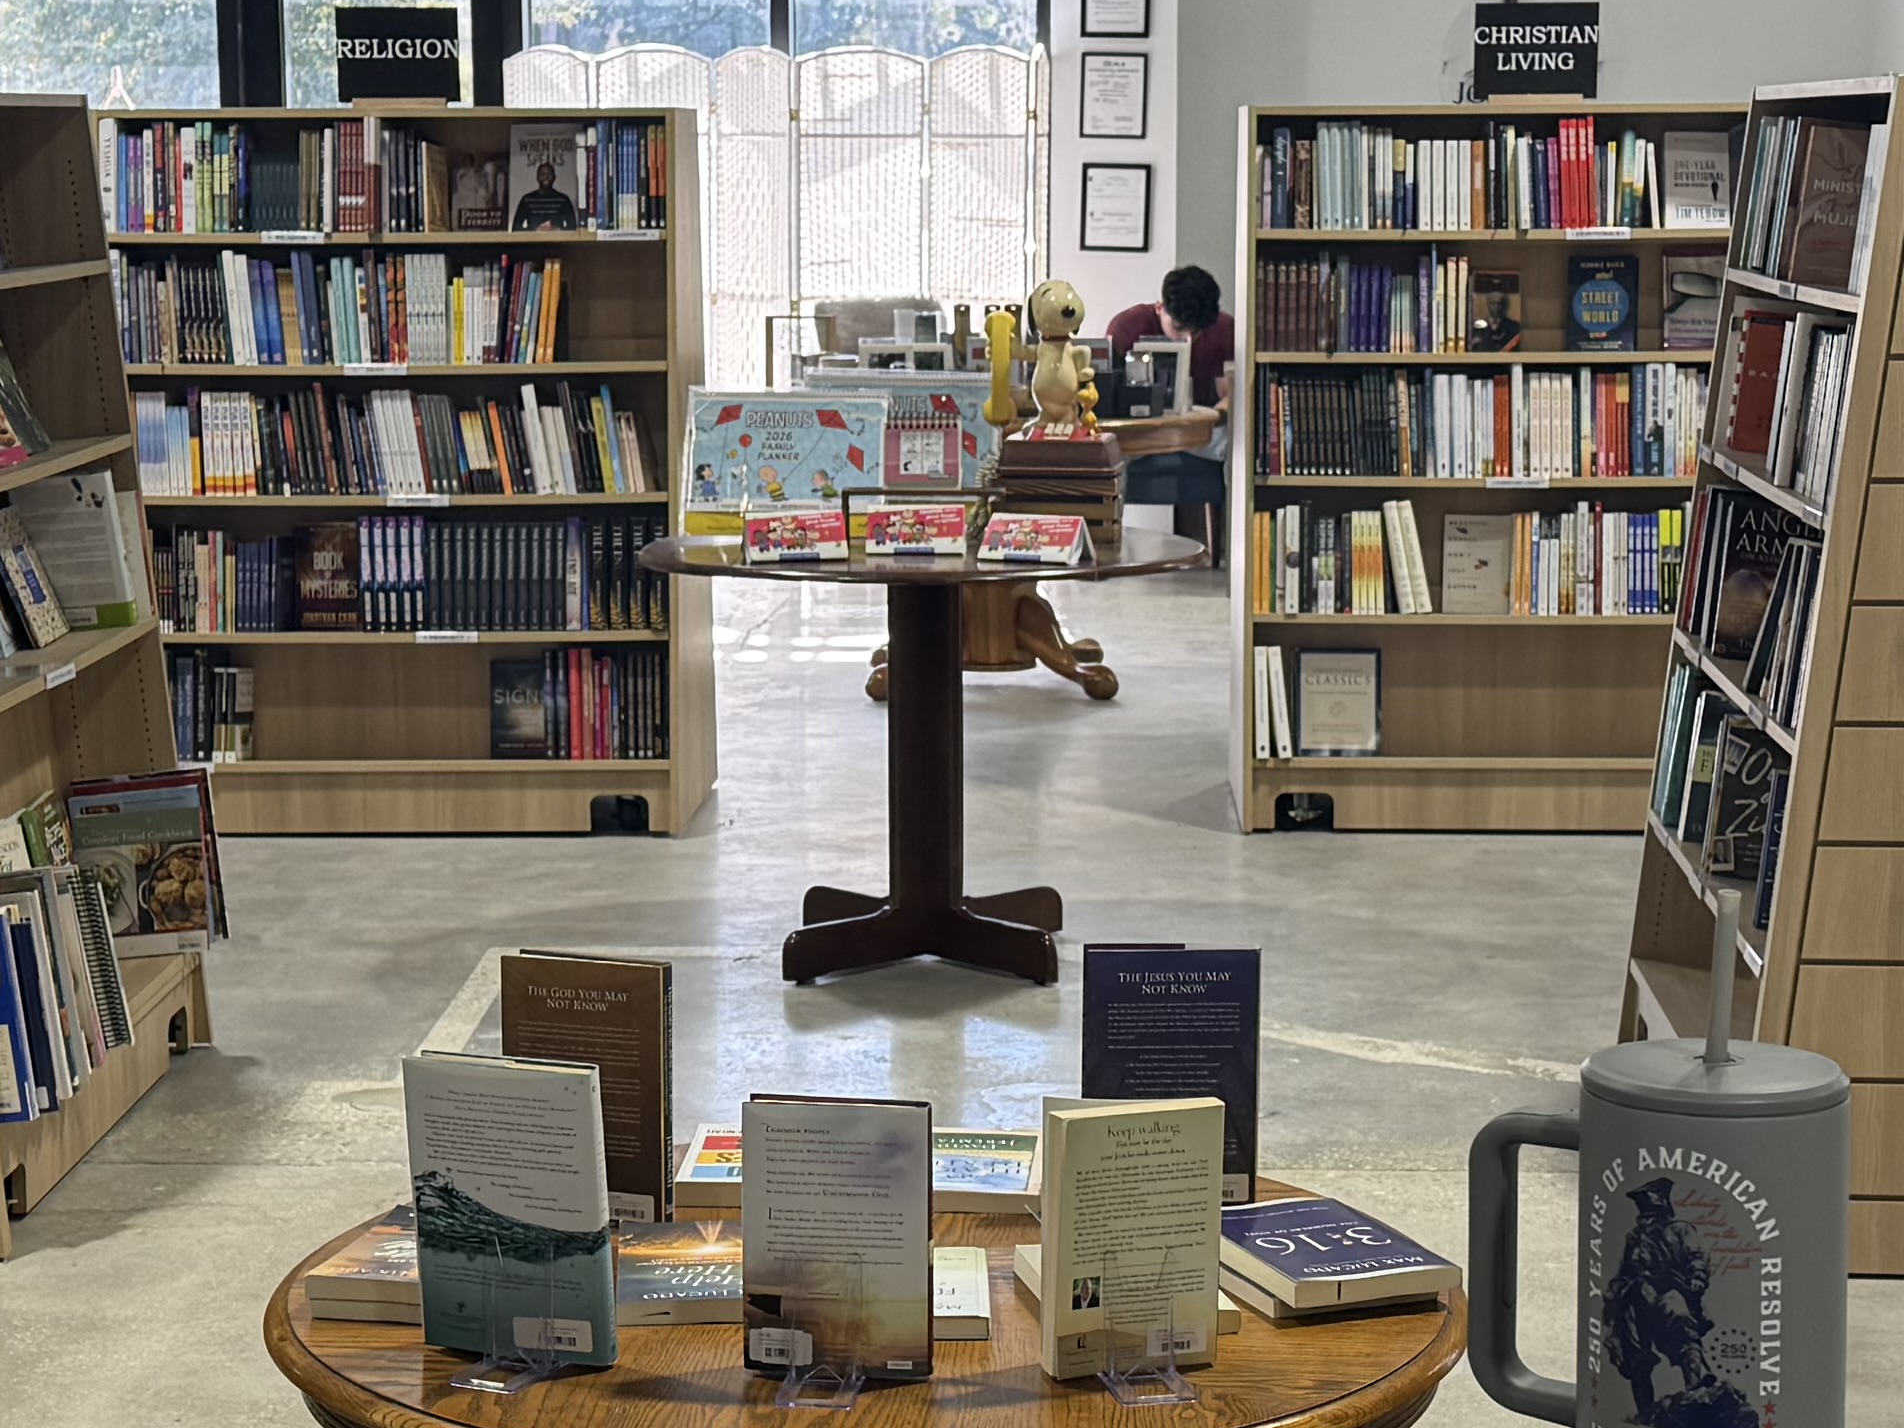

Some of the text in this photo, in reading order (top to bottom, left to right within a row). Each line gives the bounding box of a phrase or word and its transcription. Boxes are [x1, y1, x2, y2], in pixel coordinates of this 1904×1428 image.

[1474, 25, 1599, 45] CHRISTIAN
[337, 38, 458, 59] RELIGION
[1497, 52, 1574, 71] LIVING
[1695, 207, 1726, 220] TEBOW
[1582, 309, 1620, 322] WORLD
[745, 410, 814, 430] PEANUTS
[764, 431, 793, 442] 2026
[760, 442, 796, 452] FAMILY
[756, 451, 800, 462] PLANNER
[313, 551, 345, 571] BOOK
[300, 579, 358, 600] MYSTERIES
[1304, 675, 1372, 686] CLASSICS
[148, 827, 194, 841] Cookbook
[1118, 972, 1232, 984] THE JESUS YOU MAY
[528, 985, 629, 1003] THE YOU MAY
[1142, 984, 1208, 995] NOT KNOW
[547, 998, 608, 1012] NOT KNOW
[1106, 1124, 1135, 1140] Keep
[1603, 1156, 1626, 1195] OF
[1637, 1145, 1782, 1243] AMERICAN
[1255, 1224, 1394, 1258] 3:16
[1588, 1194, 1608, 1299] YEARS
[1759, 1256, 1784, 1398] RESOLVE
[1585, 1317, 1602, 1376] 250
[1719, 1342, 1748, 1356] 250
